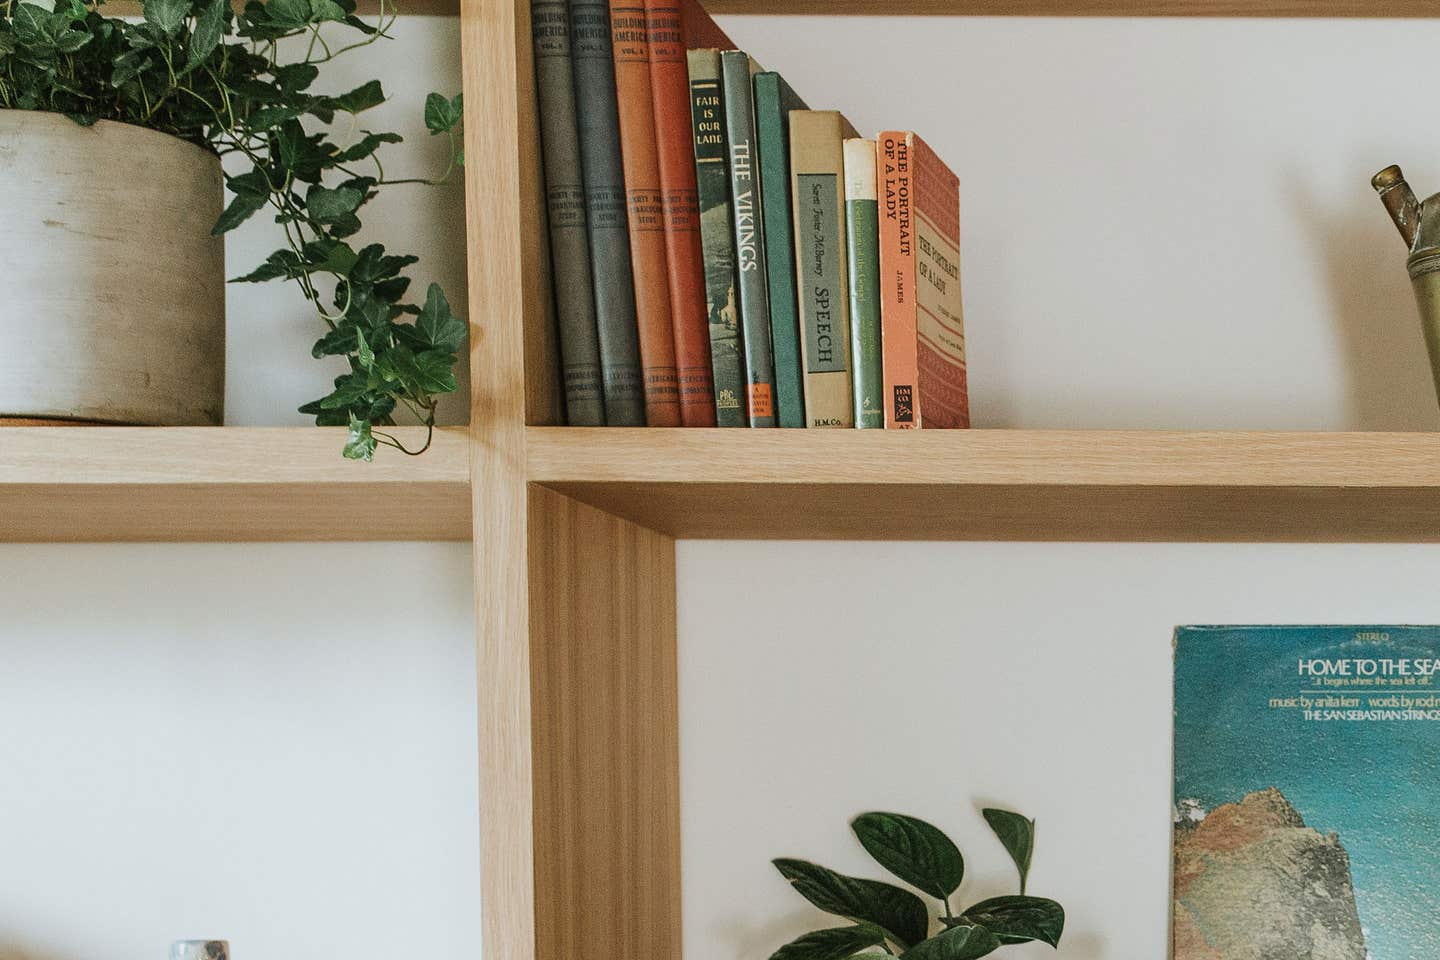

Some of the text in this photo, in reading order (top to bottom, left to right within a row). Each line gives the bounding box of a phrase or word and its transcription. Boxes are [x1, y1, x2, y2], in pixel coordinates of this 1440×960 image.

[696, 96, 719, 106] FAIR
[704, 109, 713, 118] IS
[699, 122, 720, 131] OUR
[885, 138, 896, 221] OF A LADY
[733, 139, 757, 272] THE VIKINGS
[897, 140, 910, 256] THE PORTRAIT
[919, 235, 959, 280] THE PORTRAIT
[919, 261, 928, 277] OF
[814, 287, 833, 363] SPEECH
[1298, 659, 1351, 676] HOME
[1352, 659, 1378, 676] TO
[1378, 659, 1411, 676] THE
[1375, 676, 1387, 685] the
[1269, 696, 1299, 707] music
[1300, 695, 1314, 709] by
[1315, 695, 1339, 707] anita
[1340, 695, 1360, 707] kerr
[1368, 695, 1399, 707] words
[1401, 695, 1414, 709] by
[1415, 695, 1434, 707] rod
[1303, 710, 1321, 720] THE
[1323, 710, 1346, 720] SAN
[1347, 710, 1400, 720] SEBASTIAN
